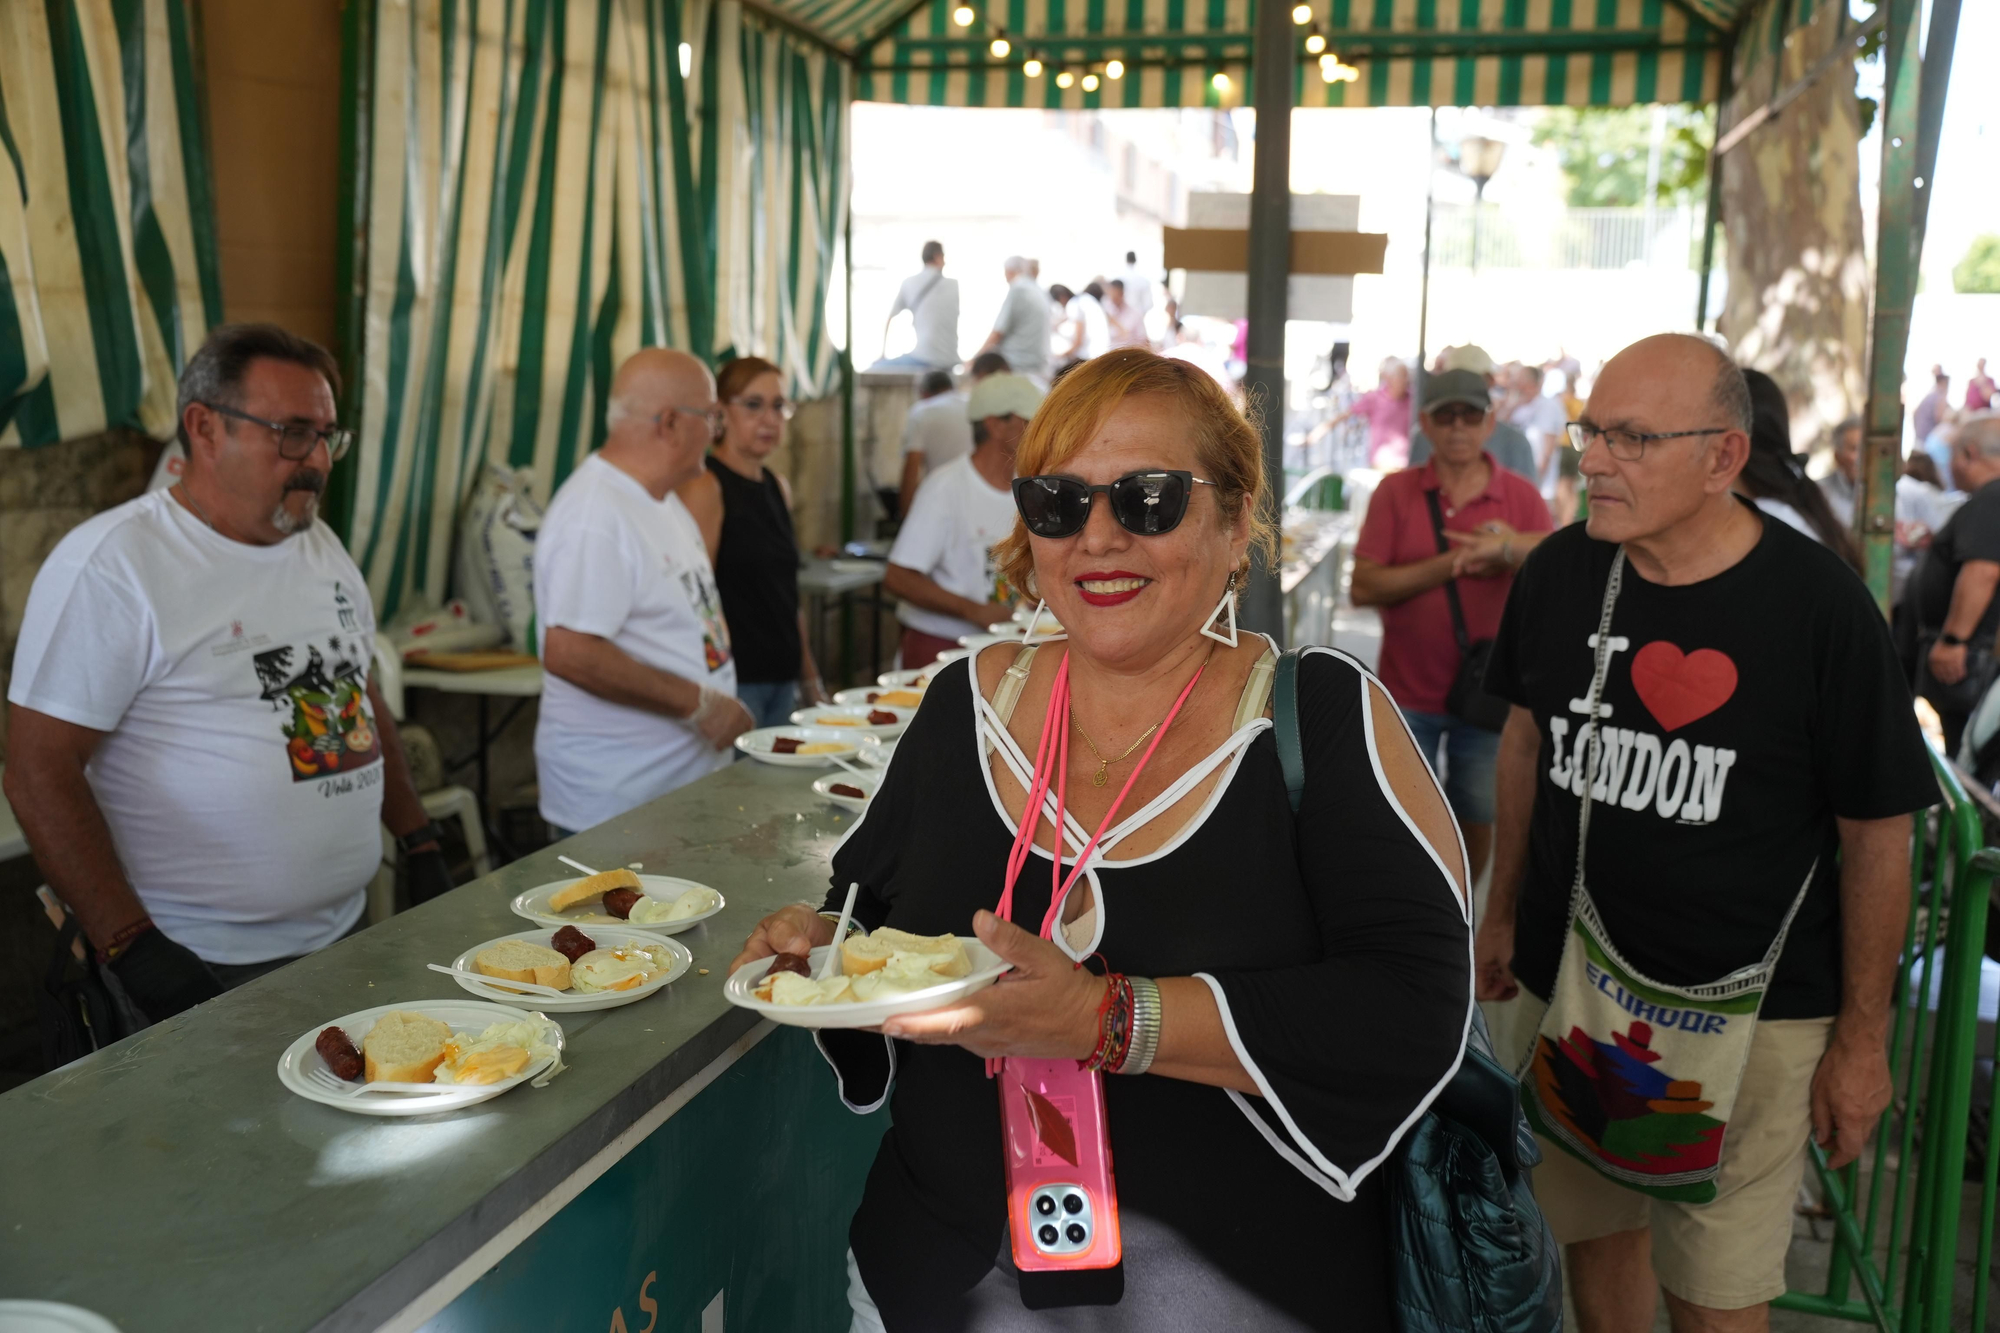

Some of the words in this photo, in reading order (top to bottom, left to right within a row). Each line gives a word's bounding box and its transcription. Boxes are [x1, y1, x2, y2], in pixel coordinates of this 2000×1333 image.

[1569, 633, 1630, 718] I
[1549, 715, 1737, 822] LONDON
[1585, 961, 1728, 1035] ECUADOR
